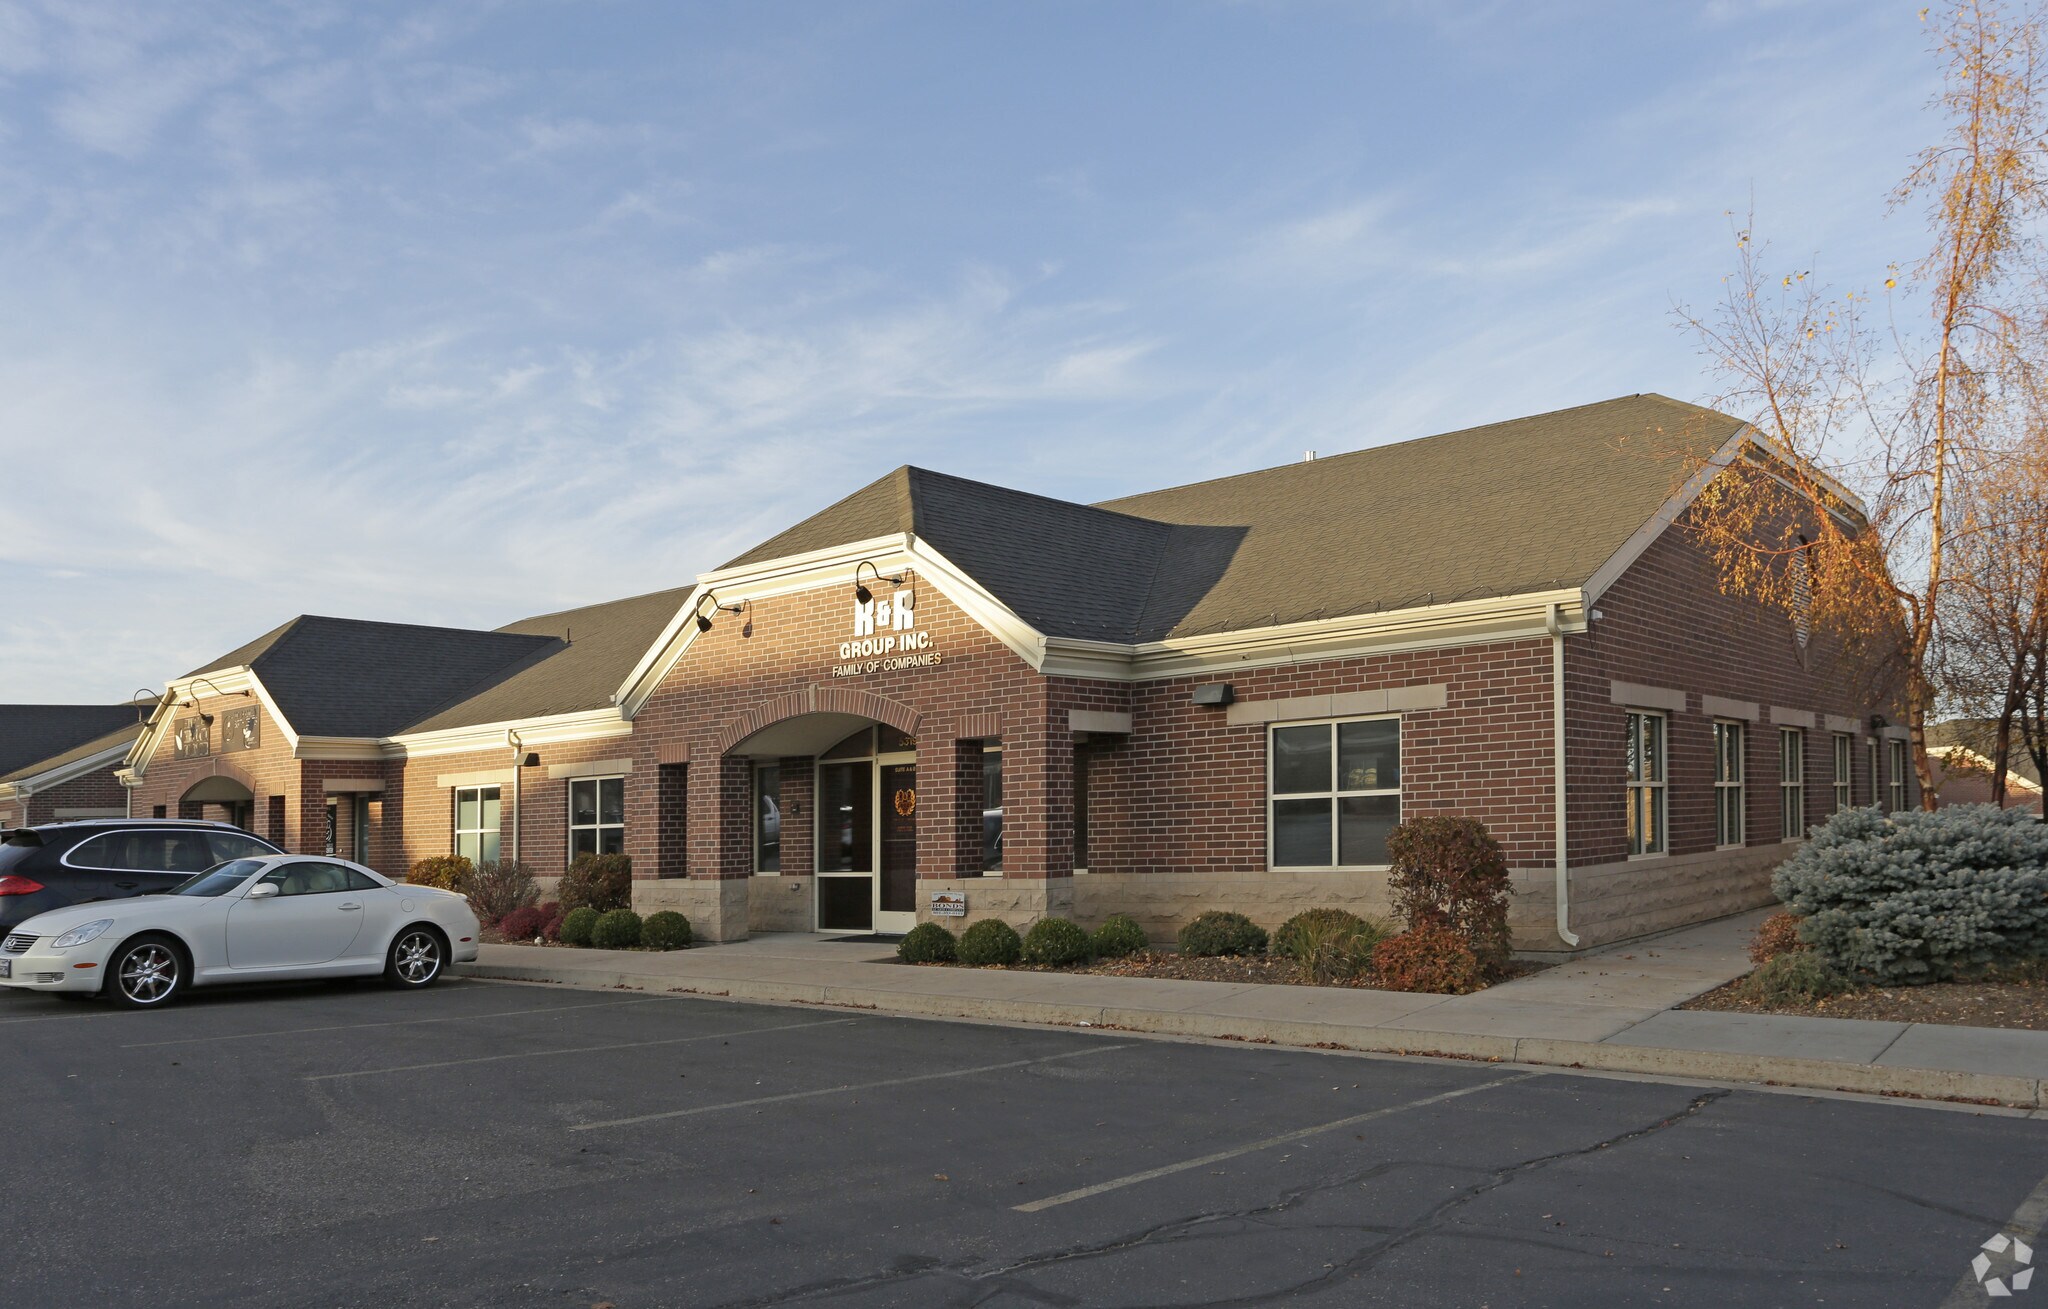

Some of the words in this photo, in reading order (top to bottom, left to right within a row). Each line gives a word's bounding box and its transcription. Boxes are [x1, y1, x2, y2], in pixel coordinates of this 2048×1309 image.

[840, 636, 896, 660] GROUP
[900, 631, 934, 652] INC.
[832, 662, 864, 678] FAMILY
[866, 660, 880, 674] OF
[883, 652, 942, 672] COMPANIES
